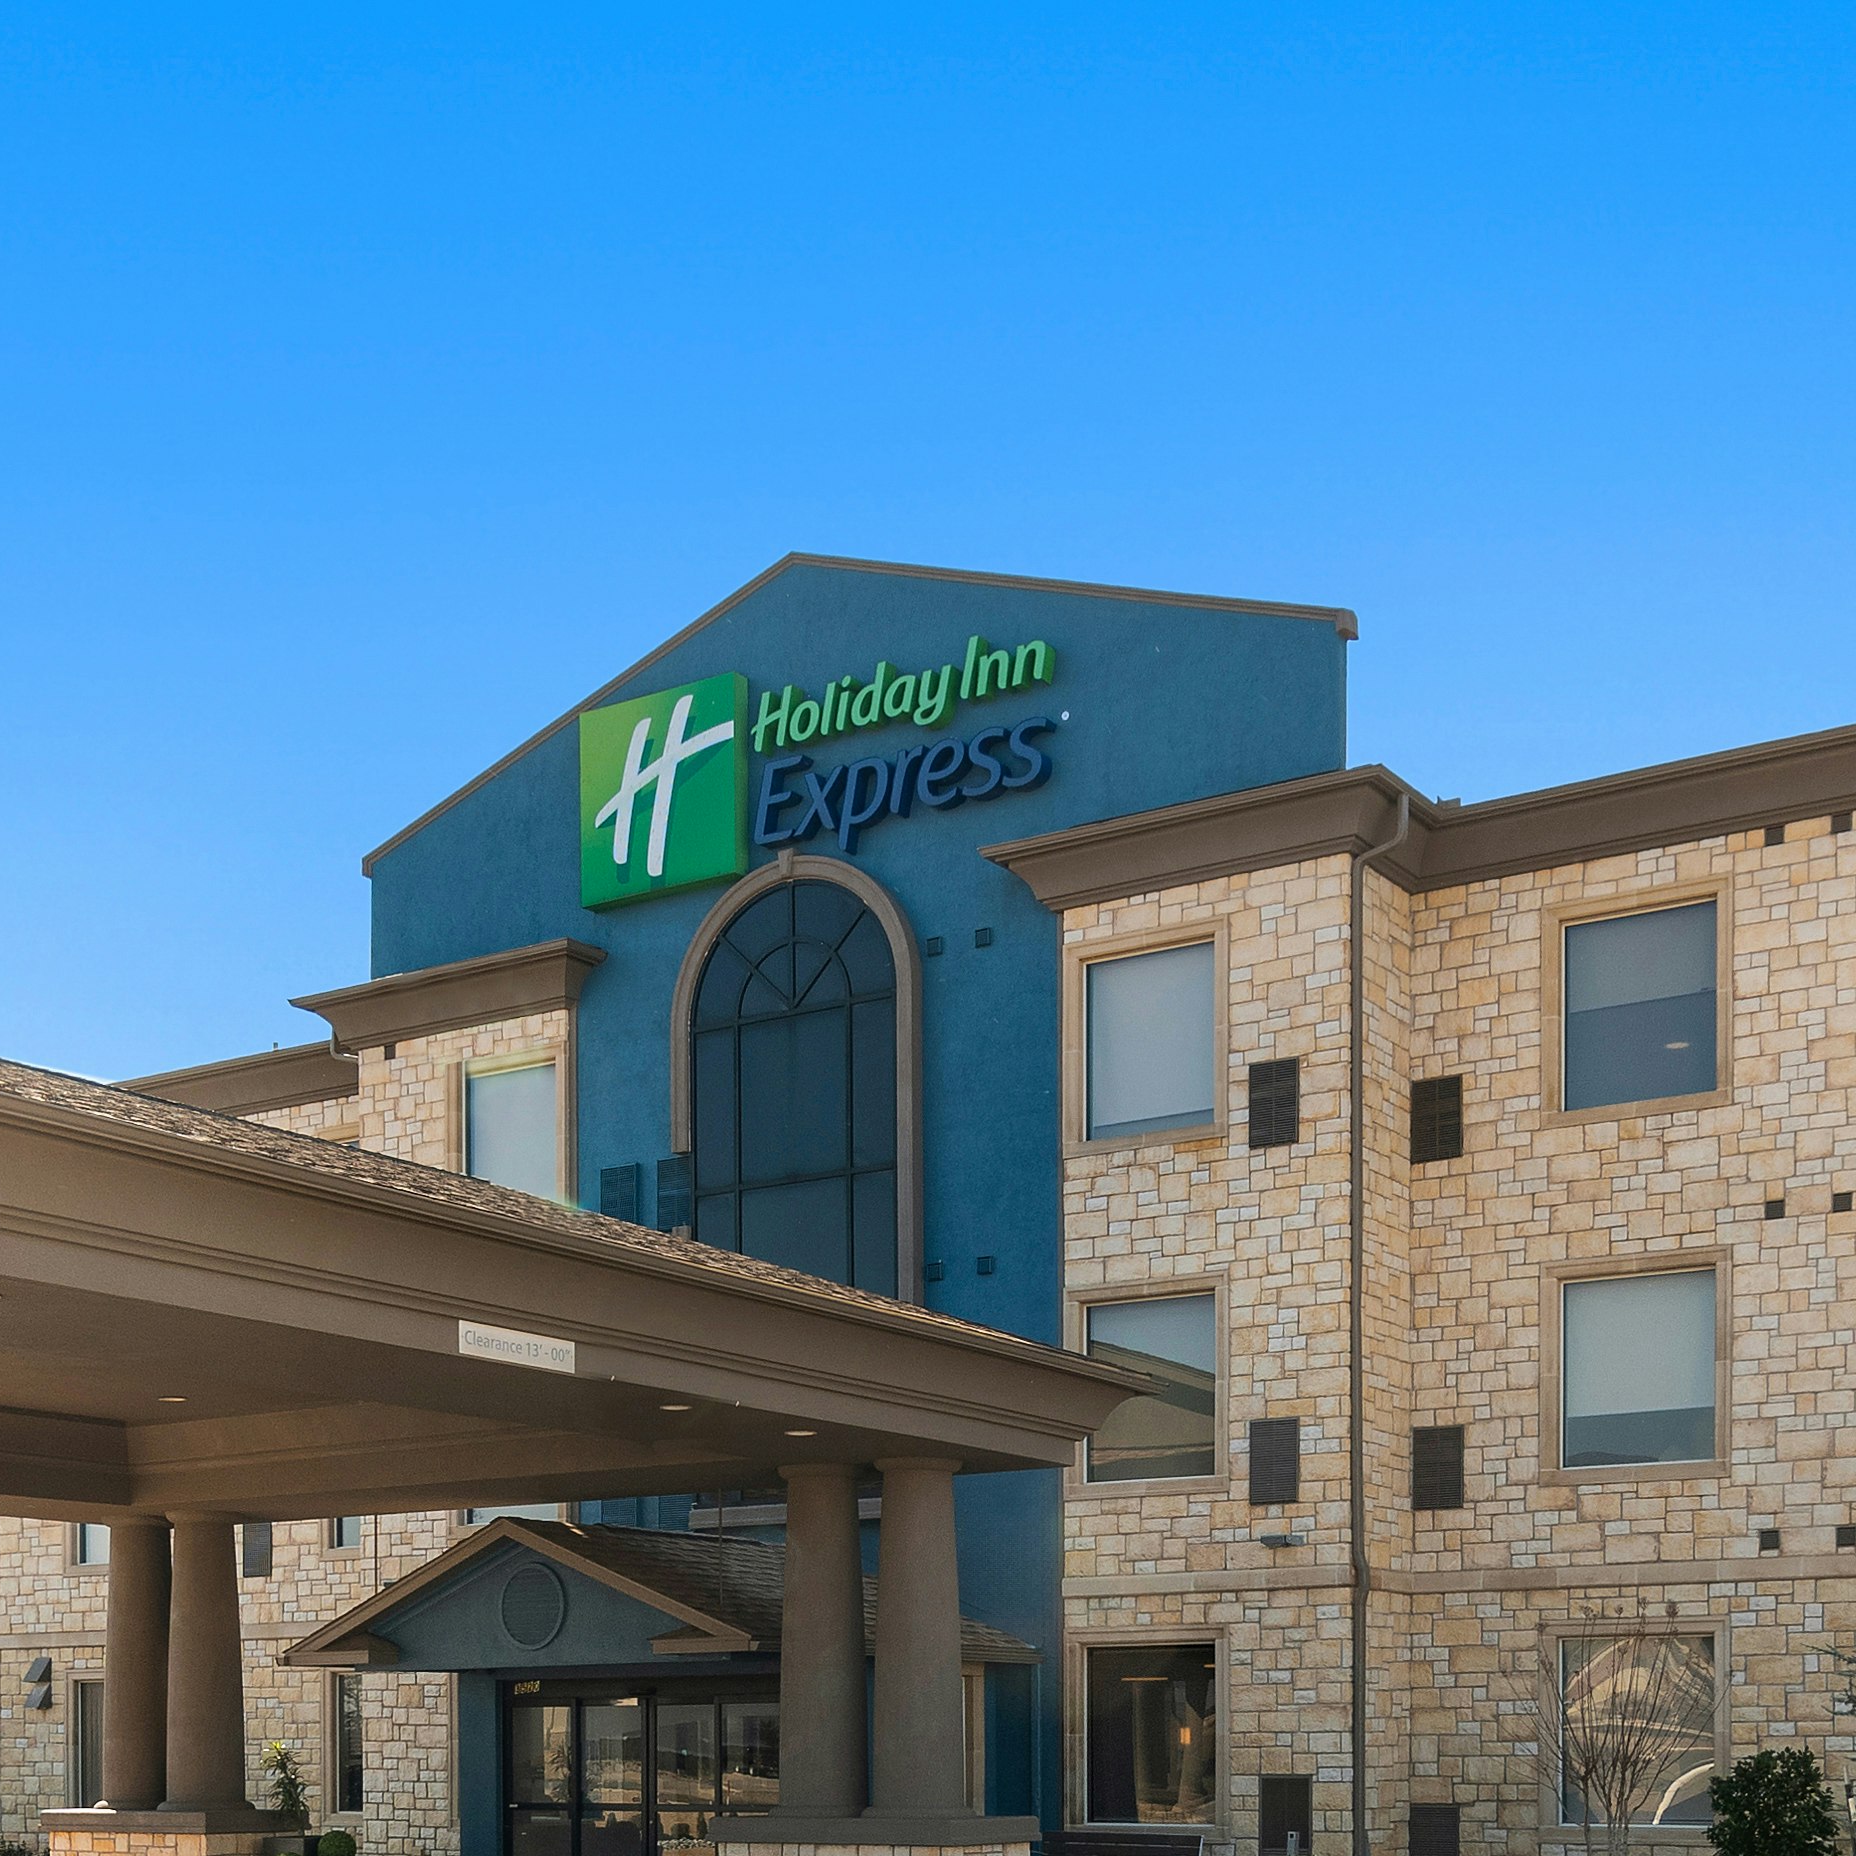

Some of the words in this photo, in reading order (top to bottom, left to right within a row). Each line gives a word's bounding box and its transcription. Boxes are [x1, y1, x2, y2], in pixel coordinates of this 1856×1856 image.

[750, 660, 954, 752] Holiday
[959, 635, 1052, 701] Inn
[595, 694, 735, 877] H
[753, 716, 1054, 854] Express
[464, 1330, 523, 1354] Clearance
